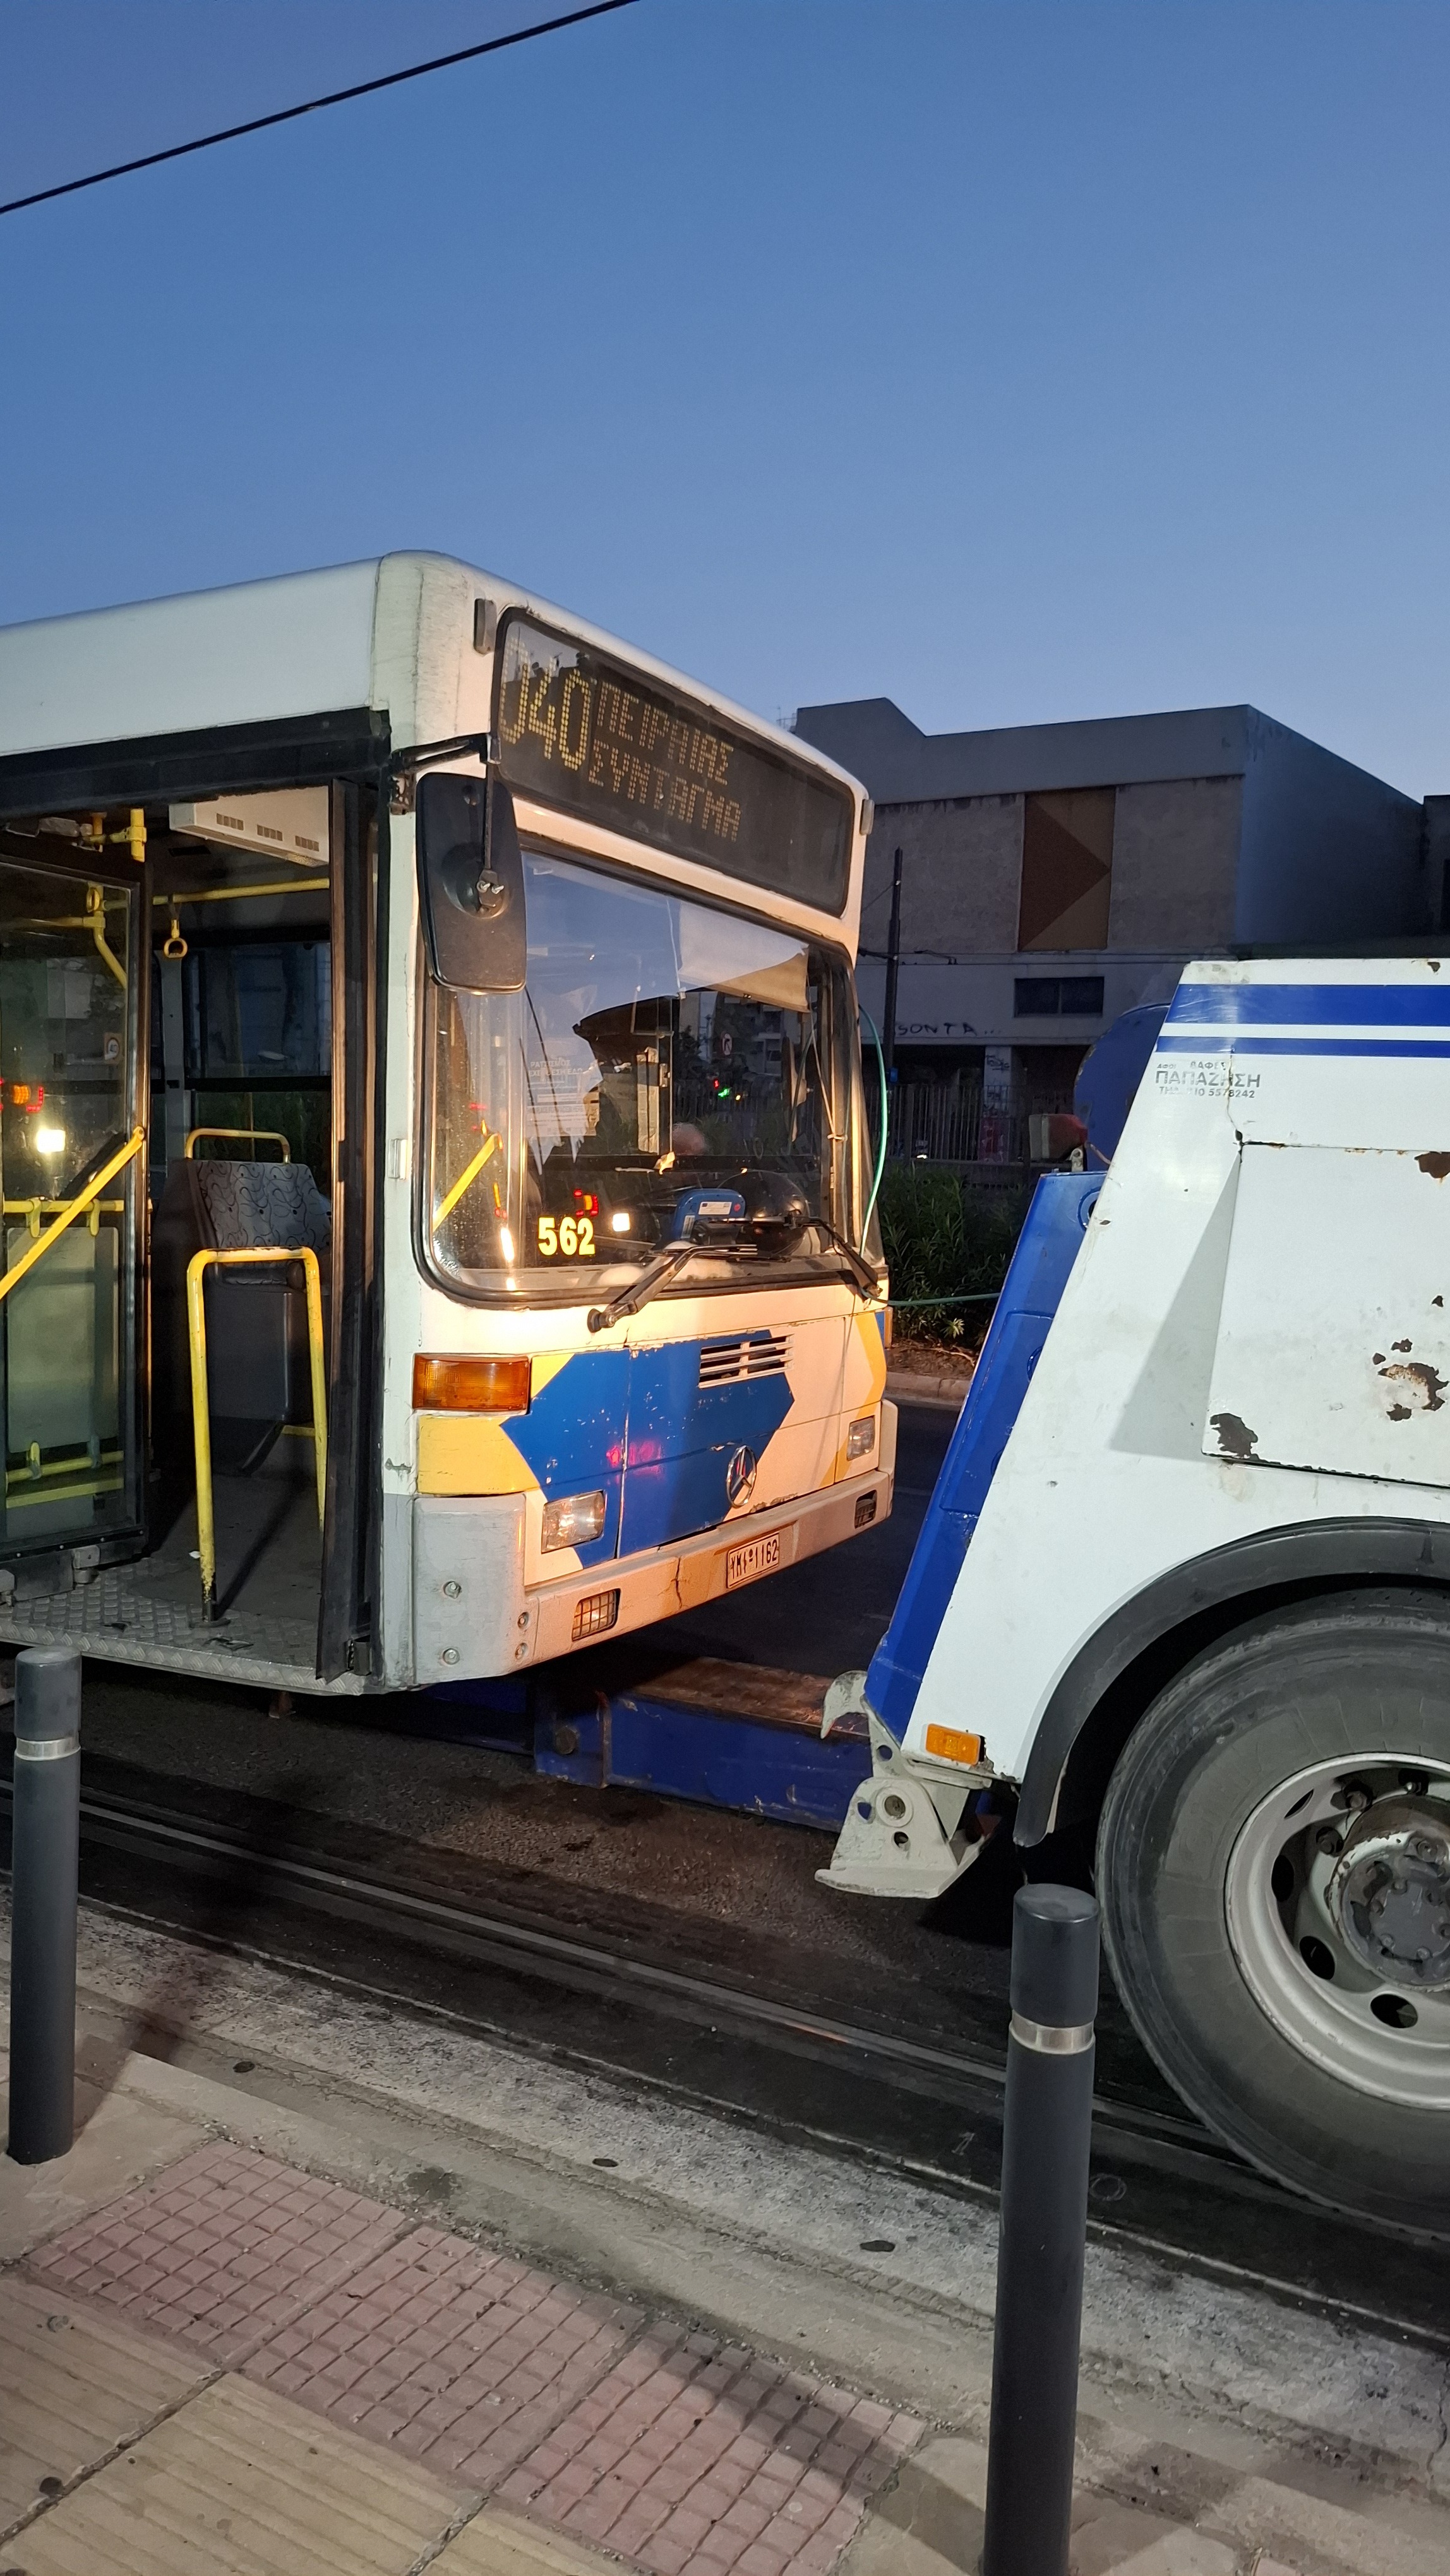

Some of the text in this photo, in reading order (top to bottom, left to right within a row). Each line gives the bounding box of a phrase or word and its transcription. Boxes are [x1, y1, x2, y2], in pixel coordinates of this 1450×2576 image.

[596, 681, 734, 786] ΠΕΙΡΑΙΑΣ
[589, 739, 741, 842] ΣΥΝΤΑΓΜΑ
[1155, 1070, 1261, 1088] ΠΑΠΑΖΗΣΗ
[537, 1216, 596, 1256] 562
